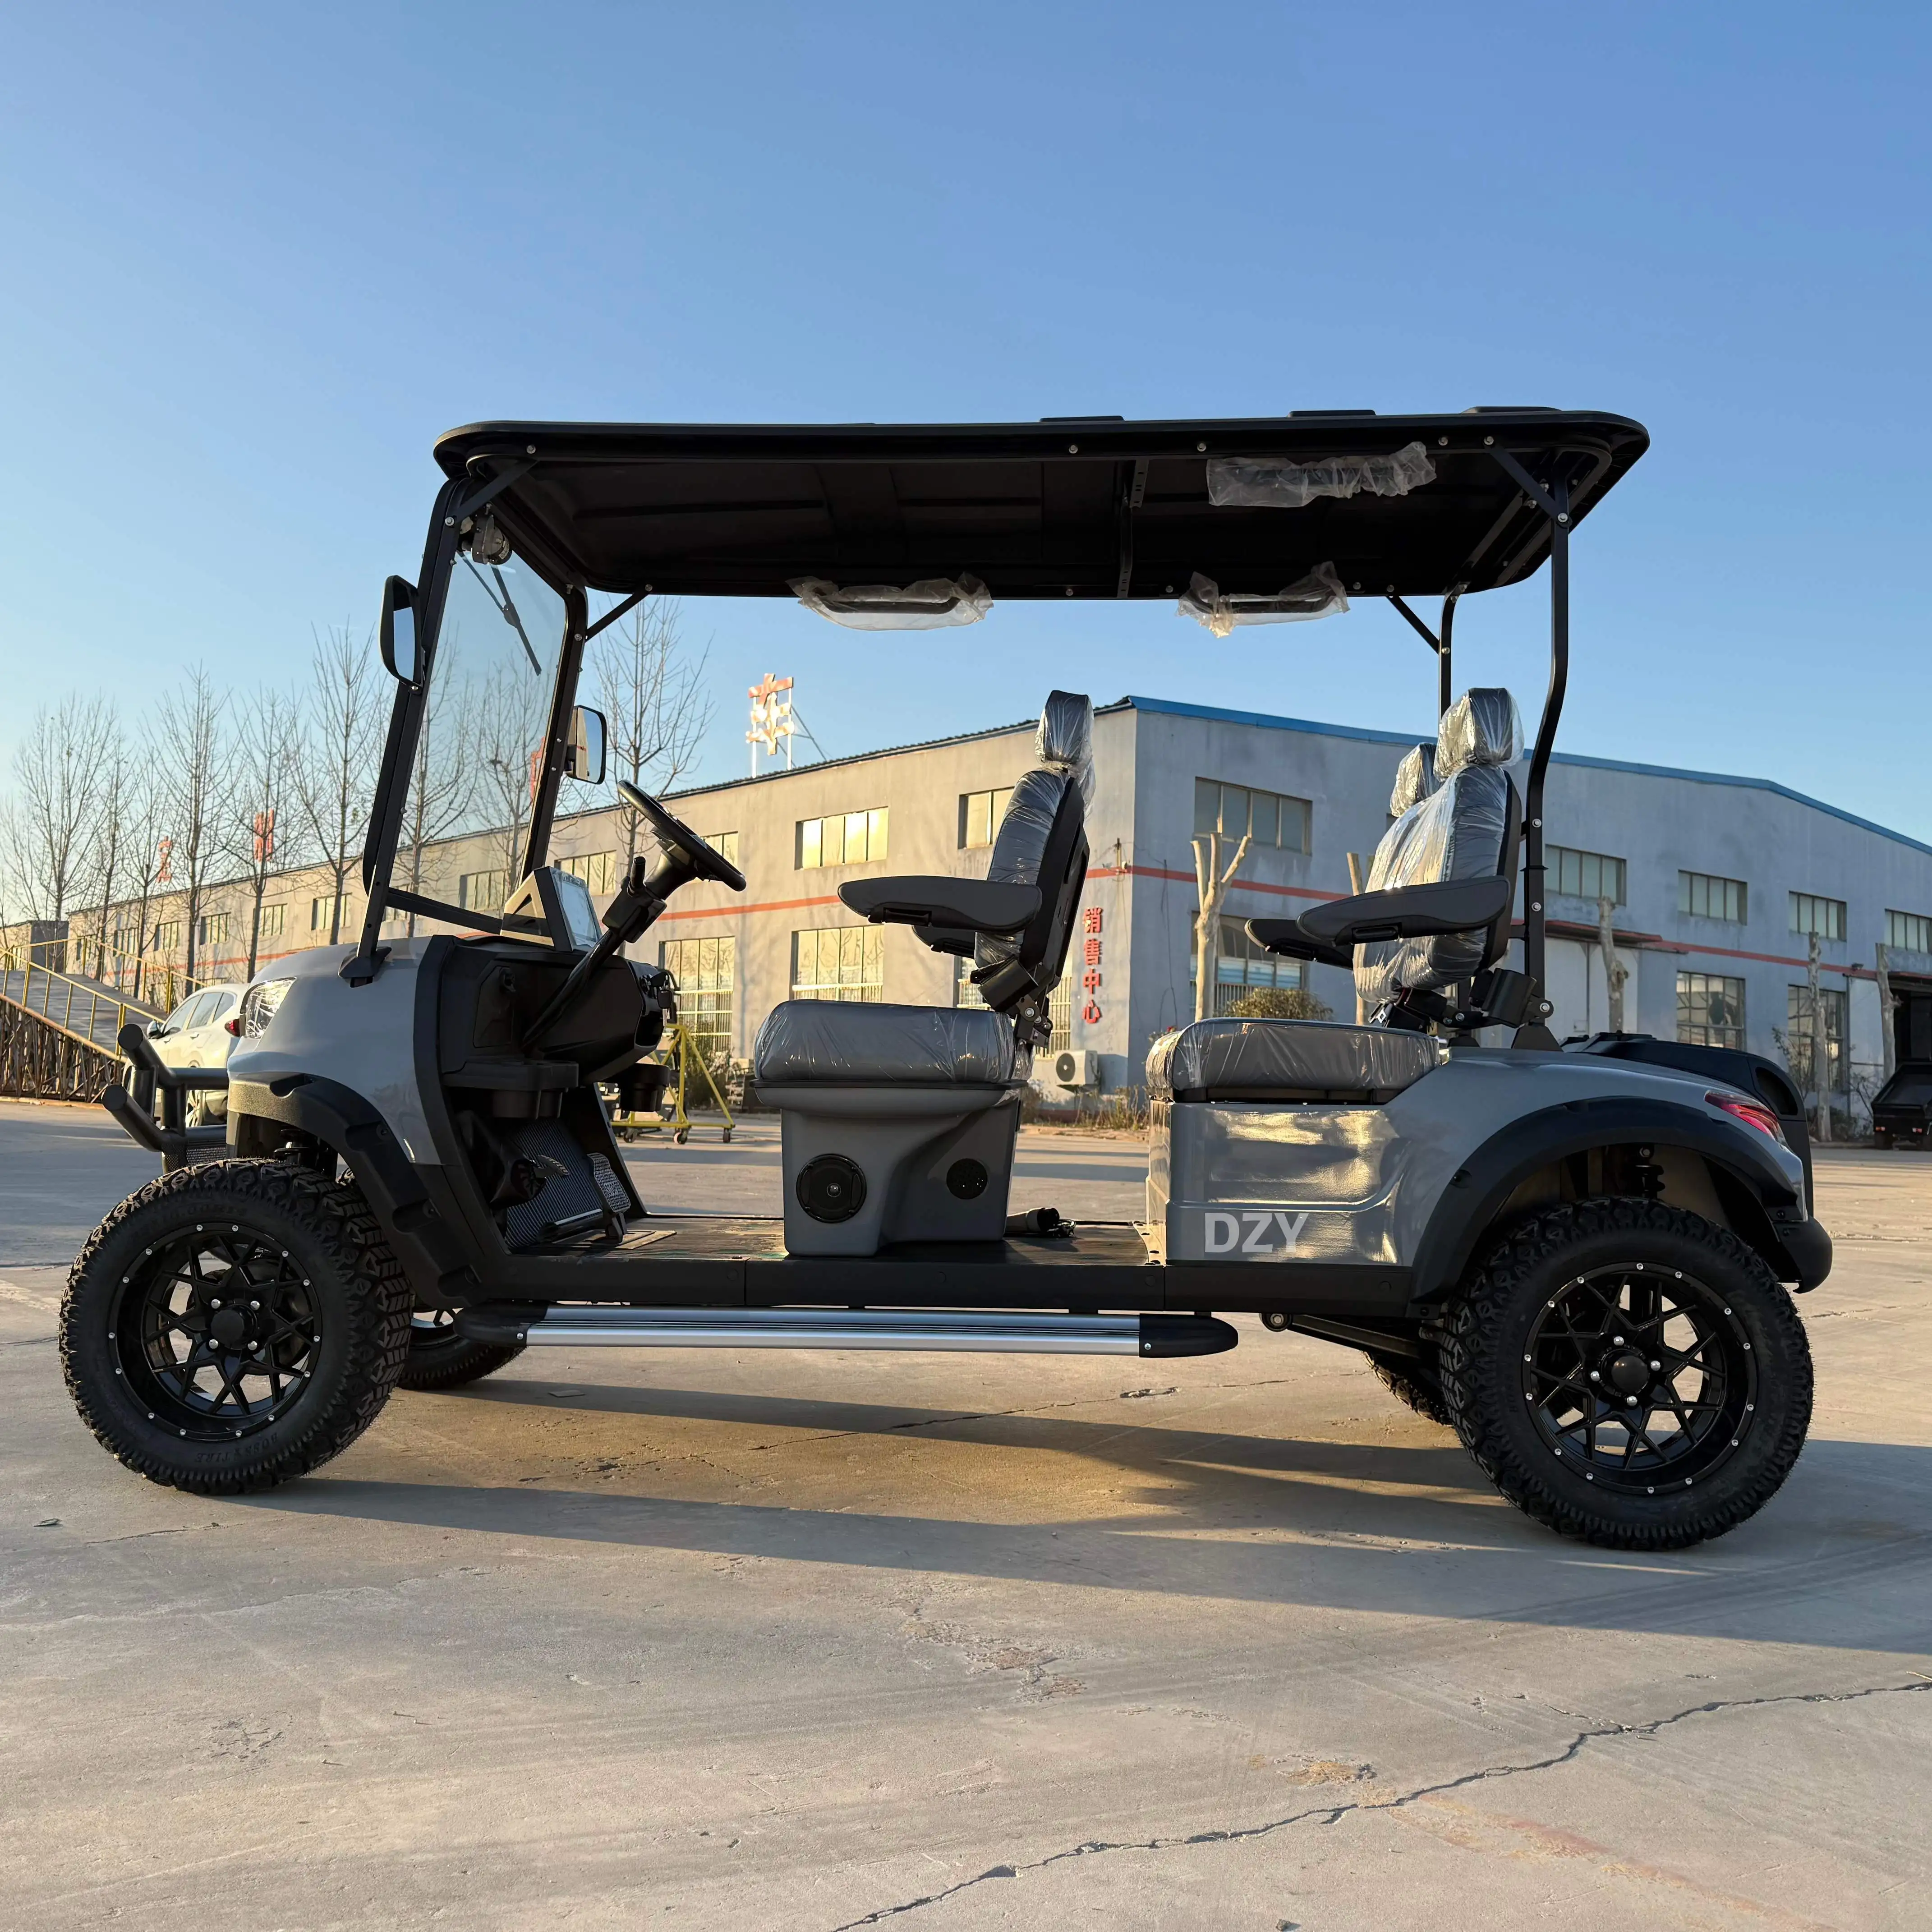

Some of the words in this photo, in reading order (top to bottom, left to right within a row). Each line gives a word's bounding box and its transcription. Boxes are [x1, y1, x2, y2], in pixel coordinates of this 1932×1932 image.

[1082, 906, 1102, 1024] 销售中心
[1205, 1213, 1309, 1253] DZY
